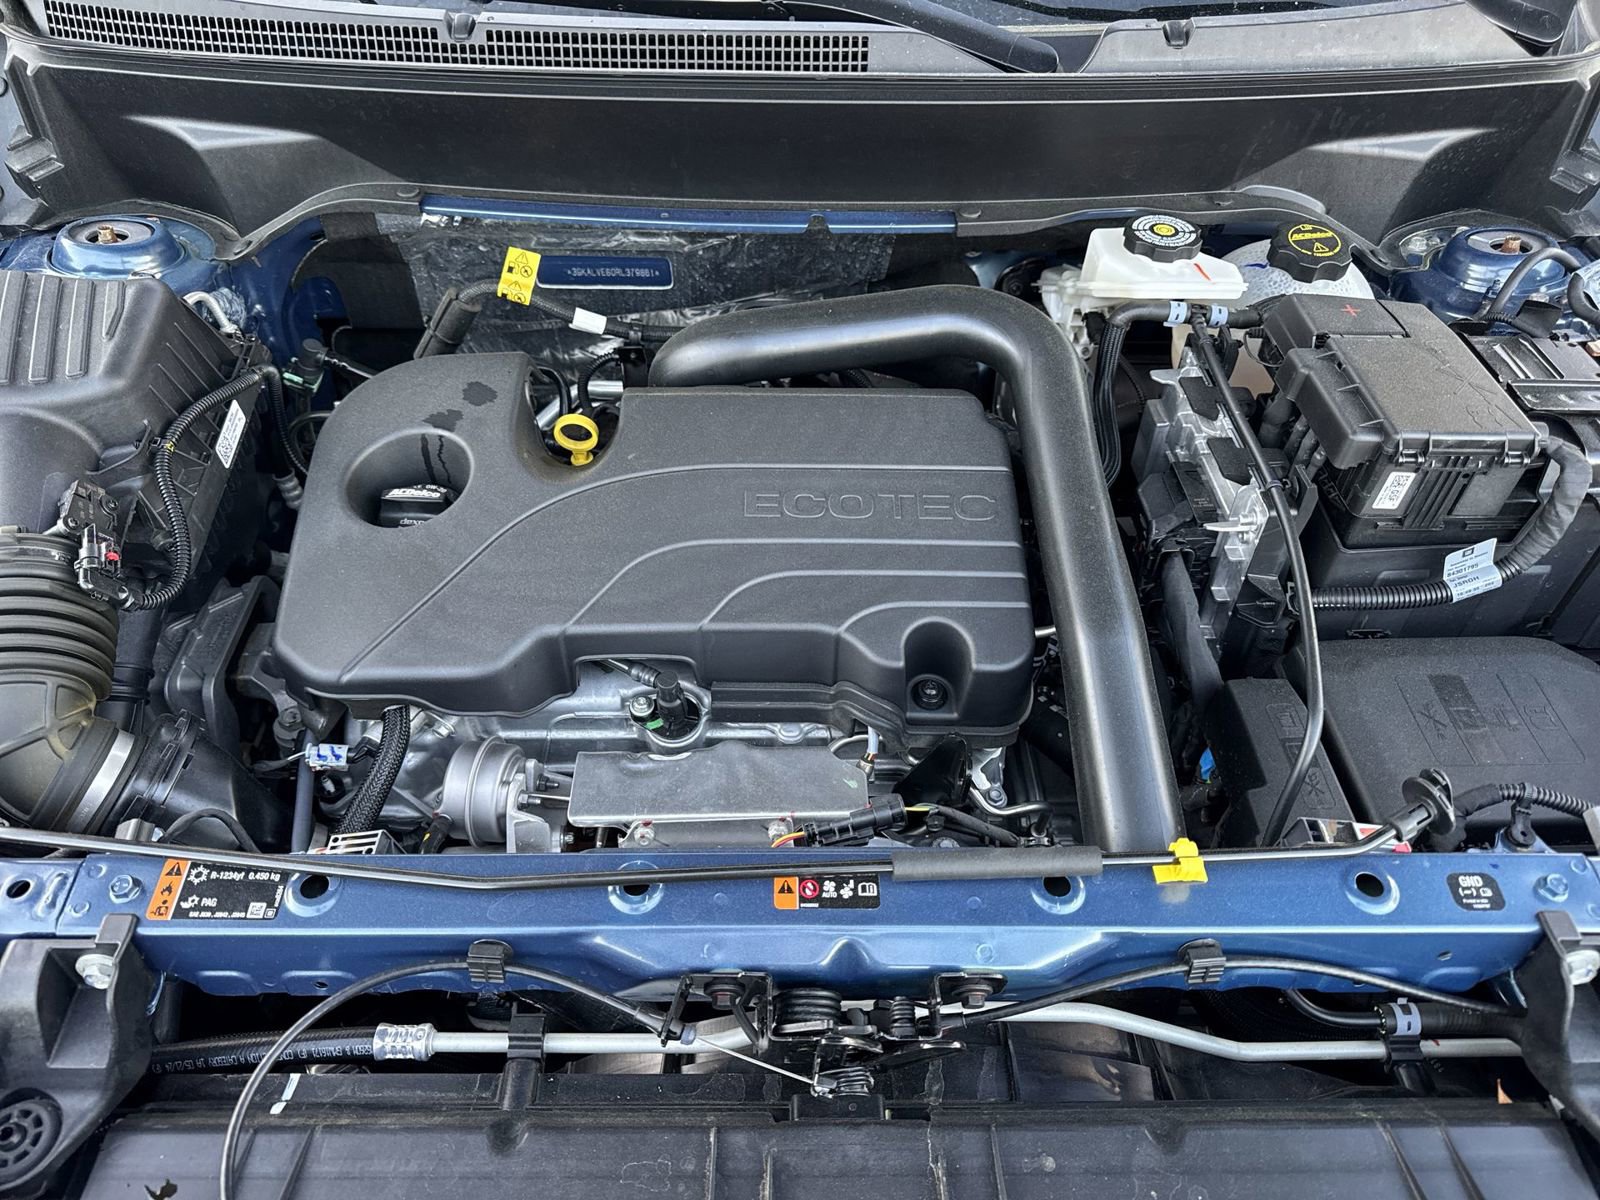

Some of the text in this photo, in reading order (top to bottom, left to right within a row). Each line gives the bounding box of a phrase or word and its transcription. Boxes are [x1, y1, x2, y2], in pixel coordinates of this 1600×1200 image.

[385, 488, 441, 498] ACDelco
[743, 490, 996, 521] ECOTEC
[210, 870, 245, 880] R-1234yf
[270, 873, 281, 882] kg
[1458, 875, 1483, 887] GND
[200, 897, 217, 907] PAG
